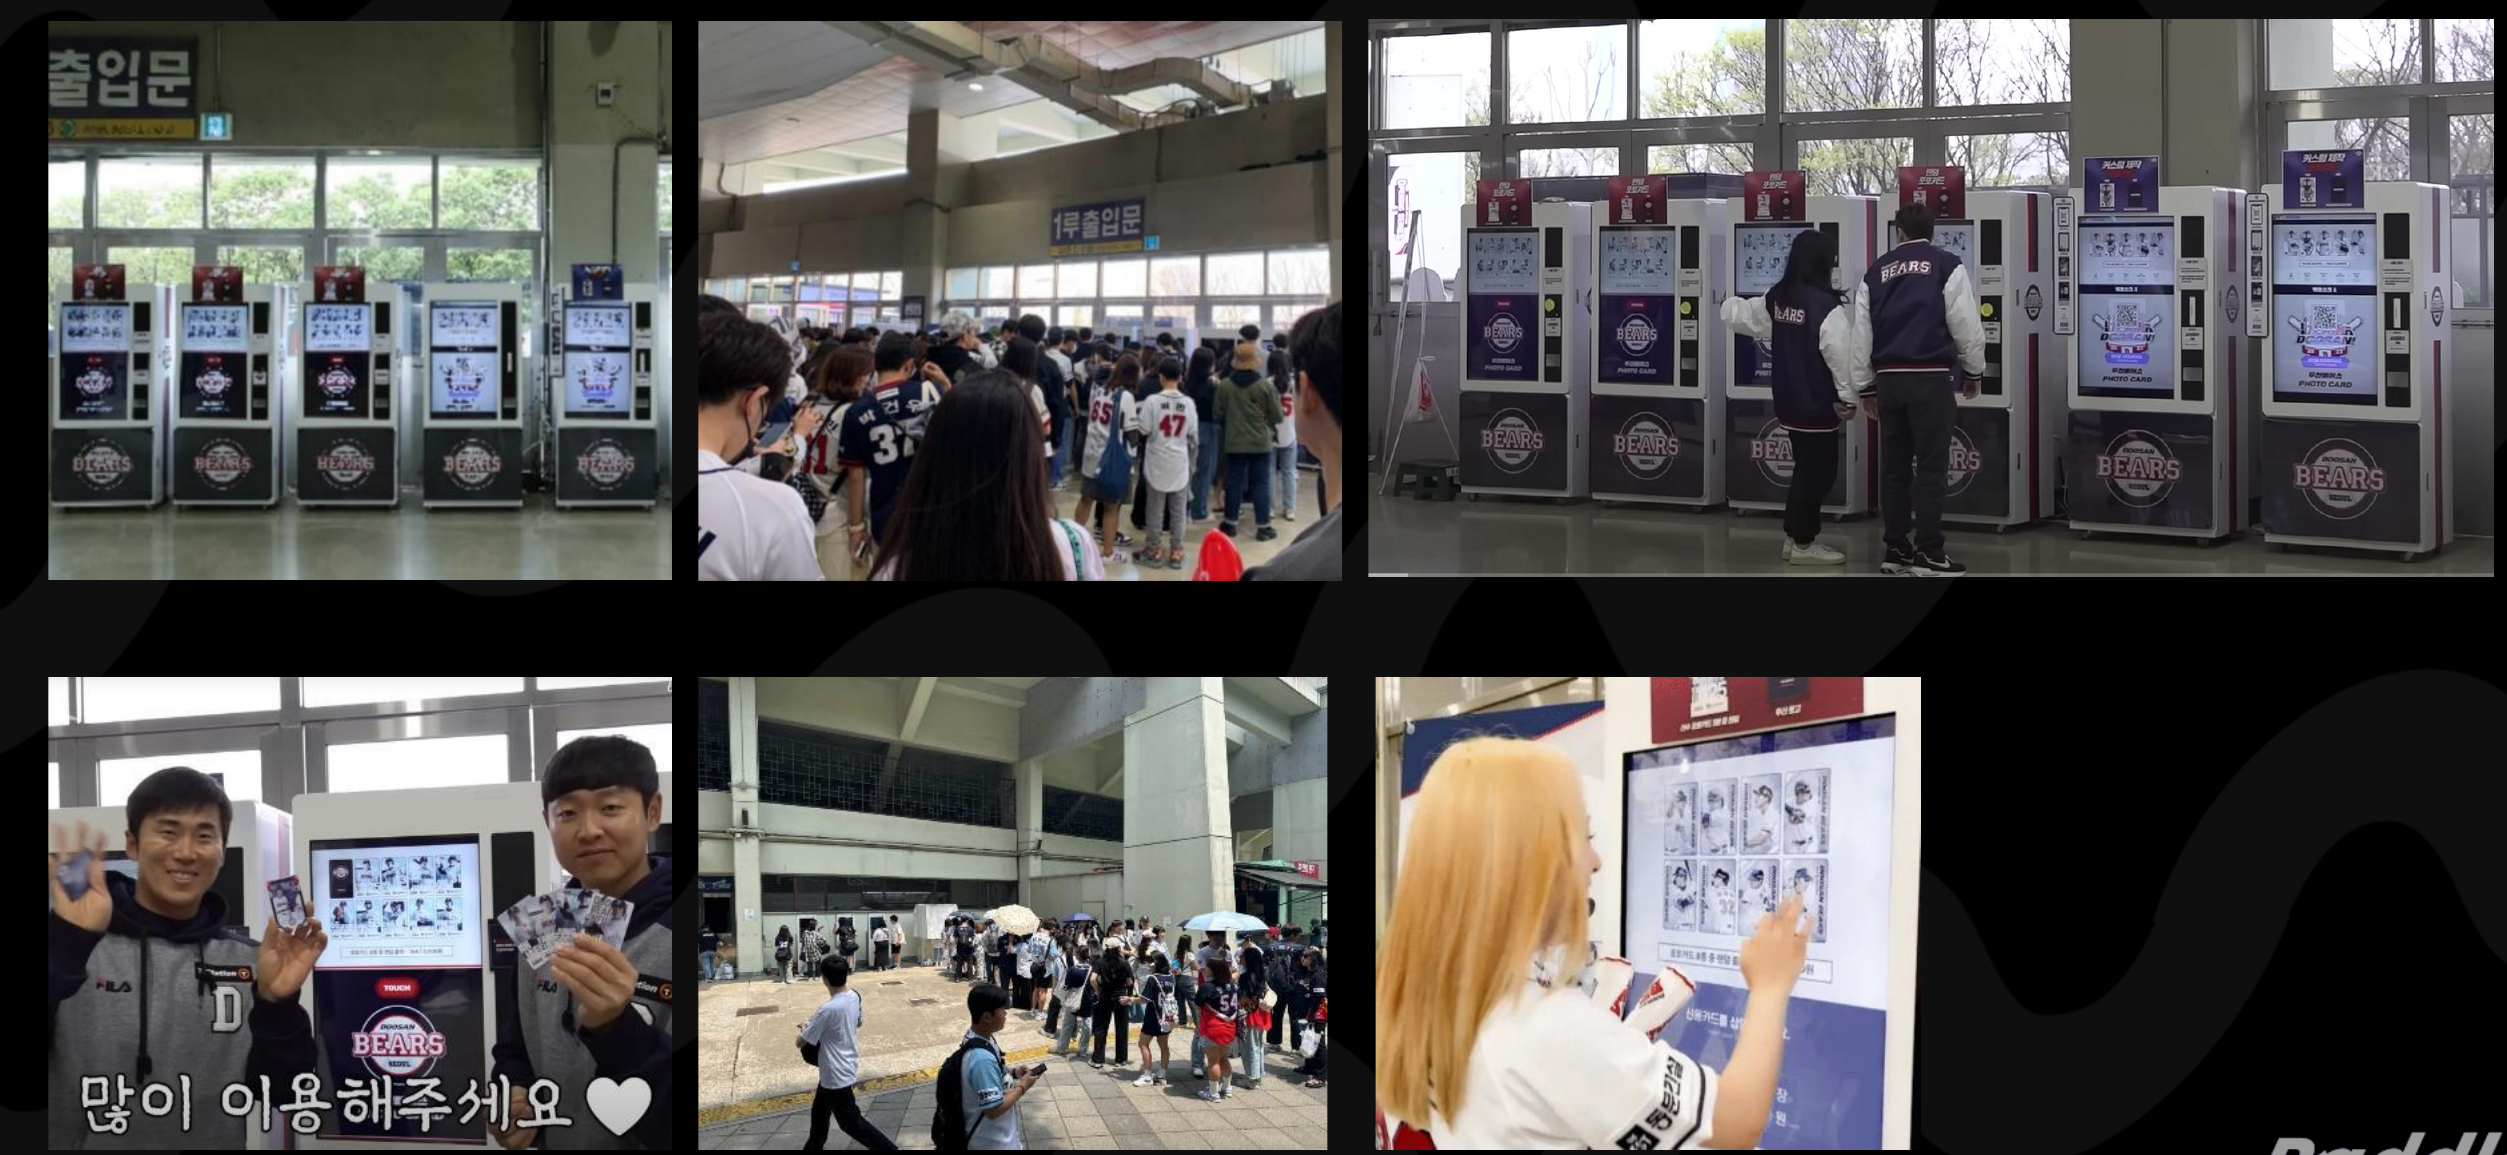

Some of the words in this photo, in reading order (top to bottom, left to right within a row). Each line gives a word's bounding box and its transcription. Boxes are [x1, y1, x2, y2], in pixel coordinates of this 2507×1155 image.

[48, 49, 191, 107] 출입문
[1881, 261, 1931, 283] BEARS
[1484, 327, 1523, 338] BEARS
[1617, 328, 1657, 341] BEARS
[1159, 414, 1186, 437] 47
[1482, 430, 1543, 449] BEARS
[1614, 435, 1679, 455] BEARS
[1752, 441, 1793, 460] BEA
[2098, 456, 2181, 480] BEARS
[2294, 465, 2385, 491] BEARS
[96, 977, 132, 992] FILA
[212, 986, 242, 1033] D
[353, 1032, 445, 1057] BEARS
[1645, 1055, 1684, 1131] 동문건설
